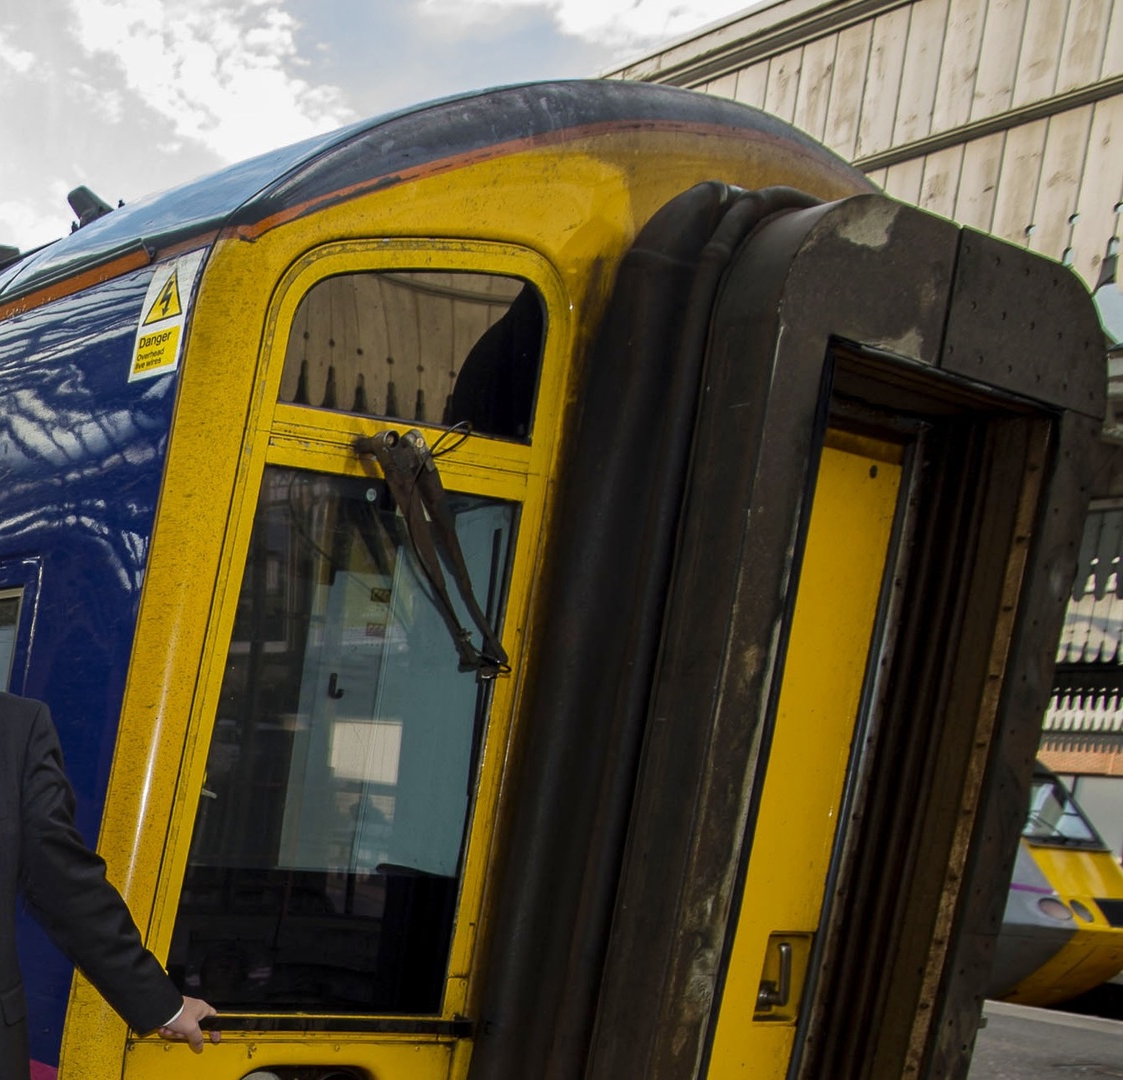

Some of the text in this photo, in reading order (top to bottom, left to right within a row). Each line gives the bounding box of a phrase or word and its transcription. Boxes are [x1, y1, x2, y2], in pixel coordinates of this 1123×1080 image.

[139, 332, 172, 348] Danger
[137, 348, 164, 361] Overhead
[135, 358, 161, 370] live wires
